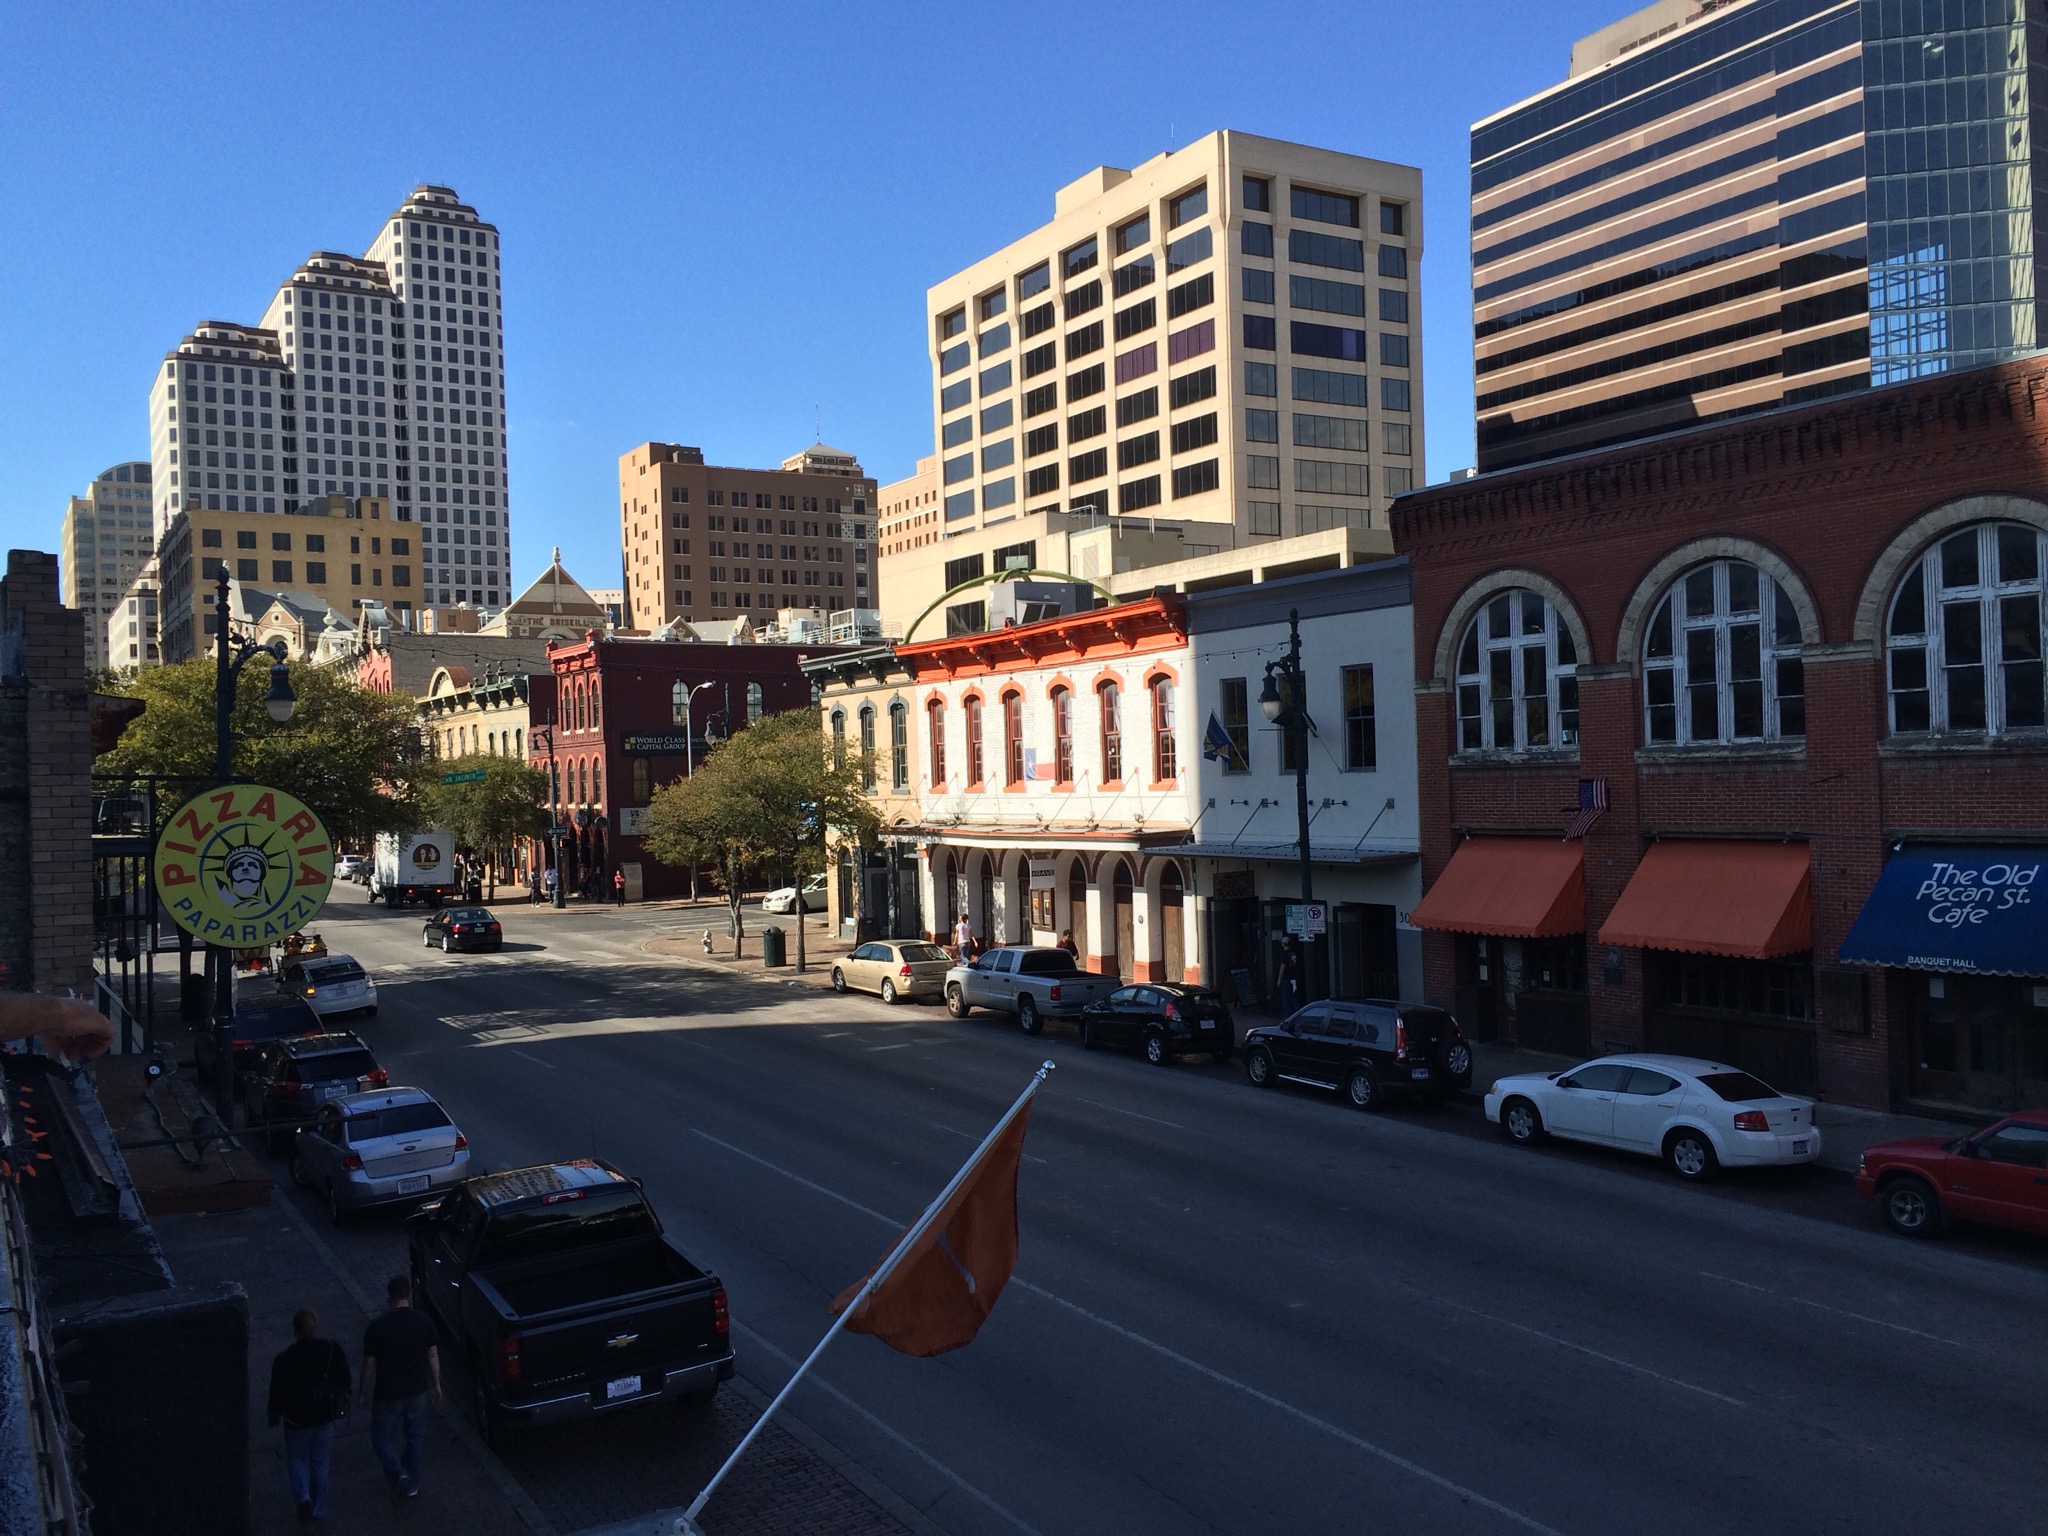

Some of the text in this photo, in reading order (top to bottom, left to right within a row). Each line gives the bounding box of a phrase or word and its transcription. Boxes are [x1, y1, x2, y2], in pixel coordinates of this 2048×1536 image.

[527, 617, 588, 627] THE DRISKILL
[665, 736, 686, 744] CLASS
[455, 773, 476, 782] JACINTO
[162, 791, 328, 887] PIZZARIA
[1931, 863, 2041, 886] The Old
[1915, 880, 1995, 902] Pecan
[173, 894, 318, 943] PAPARAZZI
[1928, 902, 1990, 929] Cafe
[1907, 955, 1977, 969] BANQUET HALL
